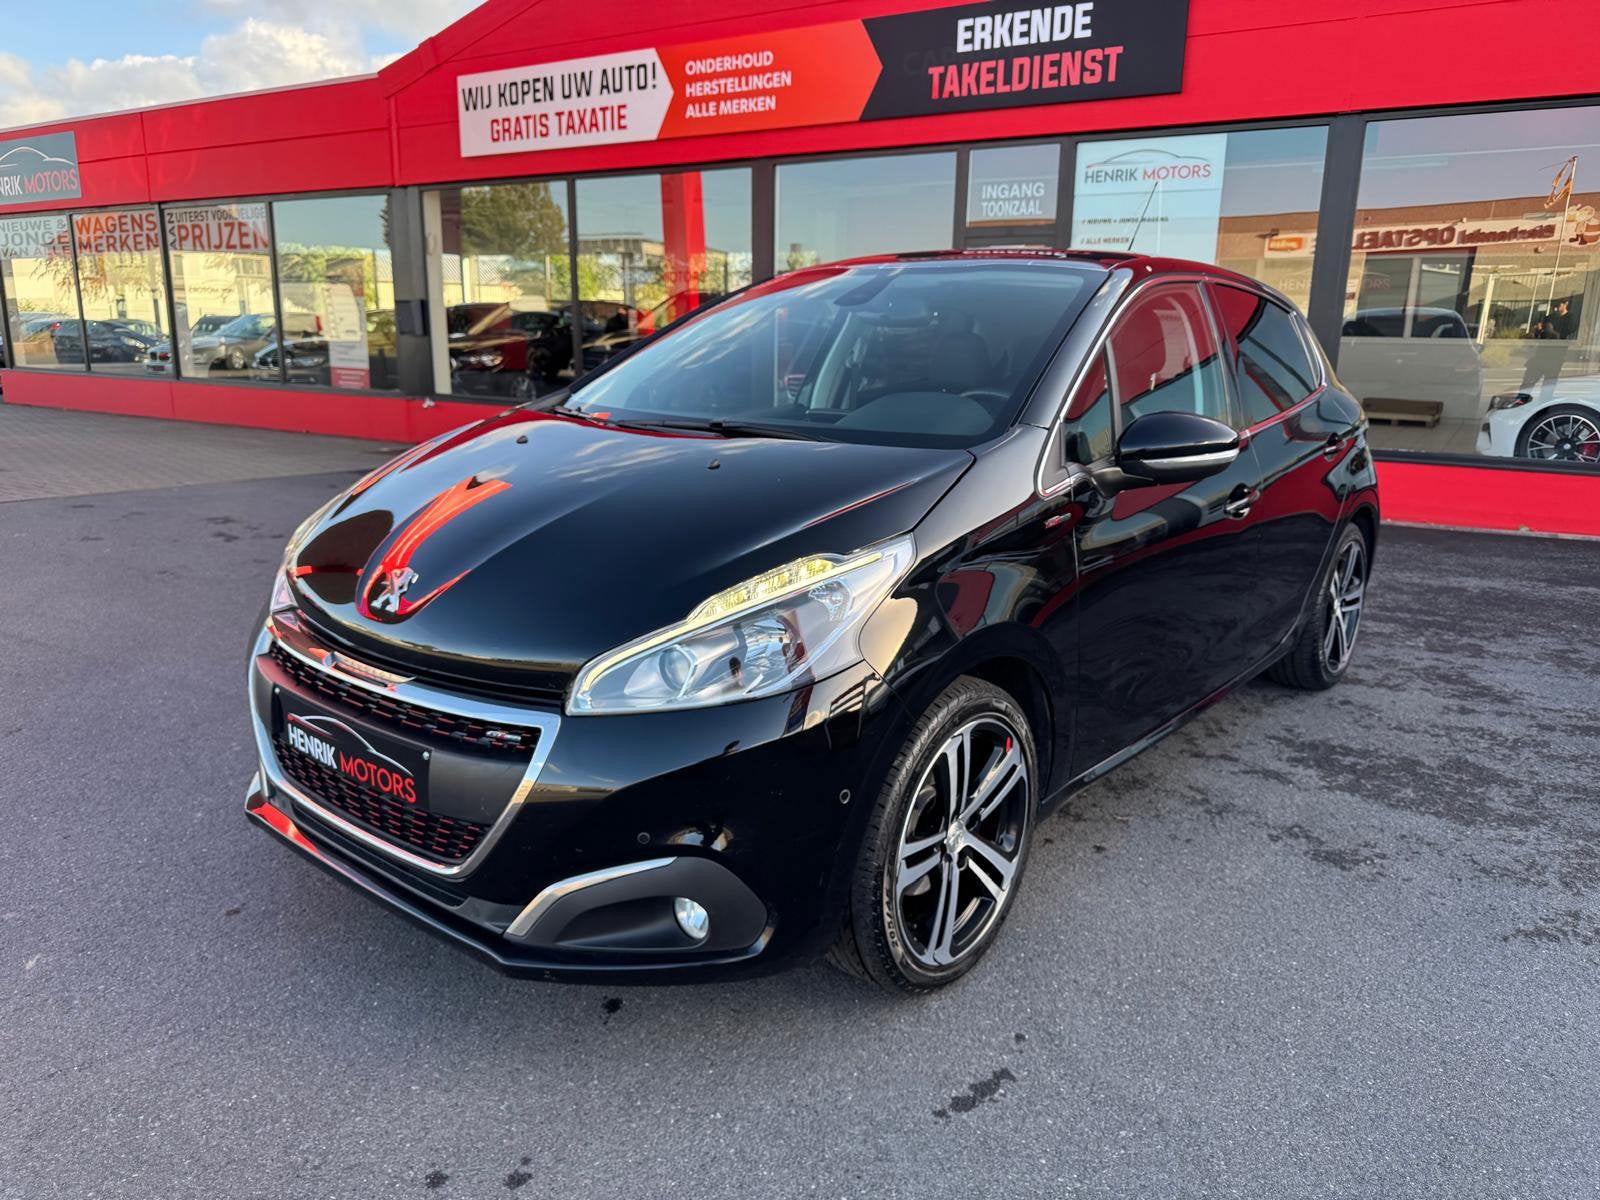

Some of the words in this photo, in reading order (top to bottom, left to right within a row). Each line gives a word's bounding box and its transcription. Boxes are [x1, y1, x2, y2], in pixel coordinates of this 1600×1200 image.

[957, 2, 1094, 53] ERKENDE
[685, 50, 774, 76] ONDERHOUD
[928, 46, 1124, 99] TAKELDIENST
[462, 84, 492, 111] WIJ
[499, 75, 554, 108] KOPEN
[561, 70, 593, 99] UW
[685, 70, 792, 98] HERSTELLINGEN
[685, 101, 717, 119] ALLE
[719, 95, 776, 115] MERKEN
[490, 113, 549, 142] GRATIS
[555, 104, 627, 136] TAXATIE
[24, 168, 78, 193] MOTORS
[1084, 168, 1138, 184] HENRIK
[1142, 164, 1212, 182] MOTORS
[982, 182, 1045, 199] INGANG
[175, 209, 210, 223] UITERST
[981, 199, 1043, 217] TOONZAAL
[57, 218, 67, 230] &
[76, 213, 158, 236] WAGENS
[177, 219, 269, 250] PRIJZEN
[0, 246, 29, 258] VAN
[78, 233, 160, 254] MERKEN
[287, 722, 338, 770] HENRIK
[340, 751, 416, 803] MOTORS
